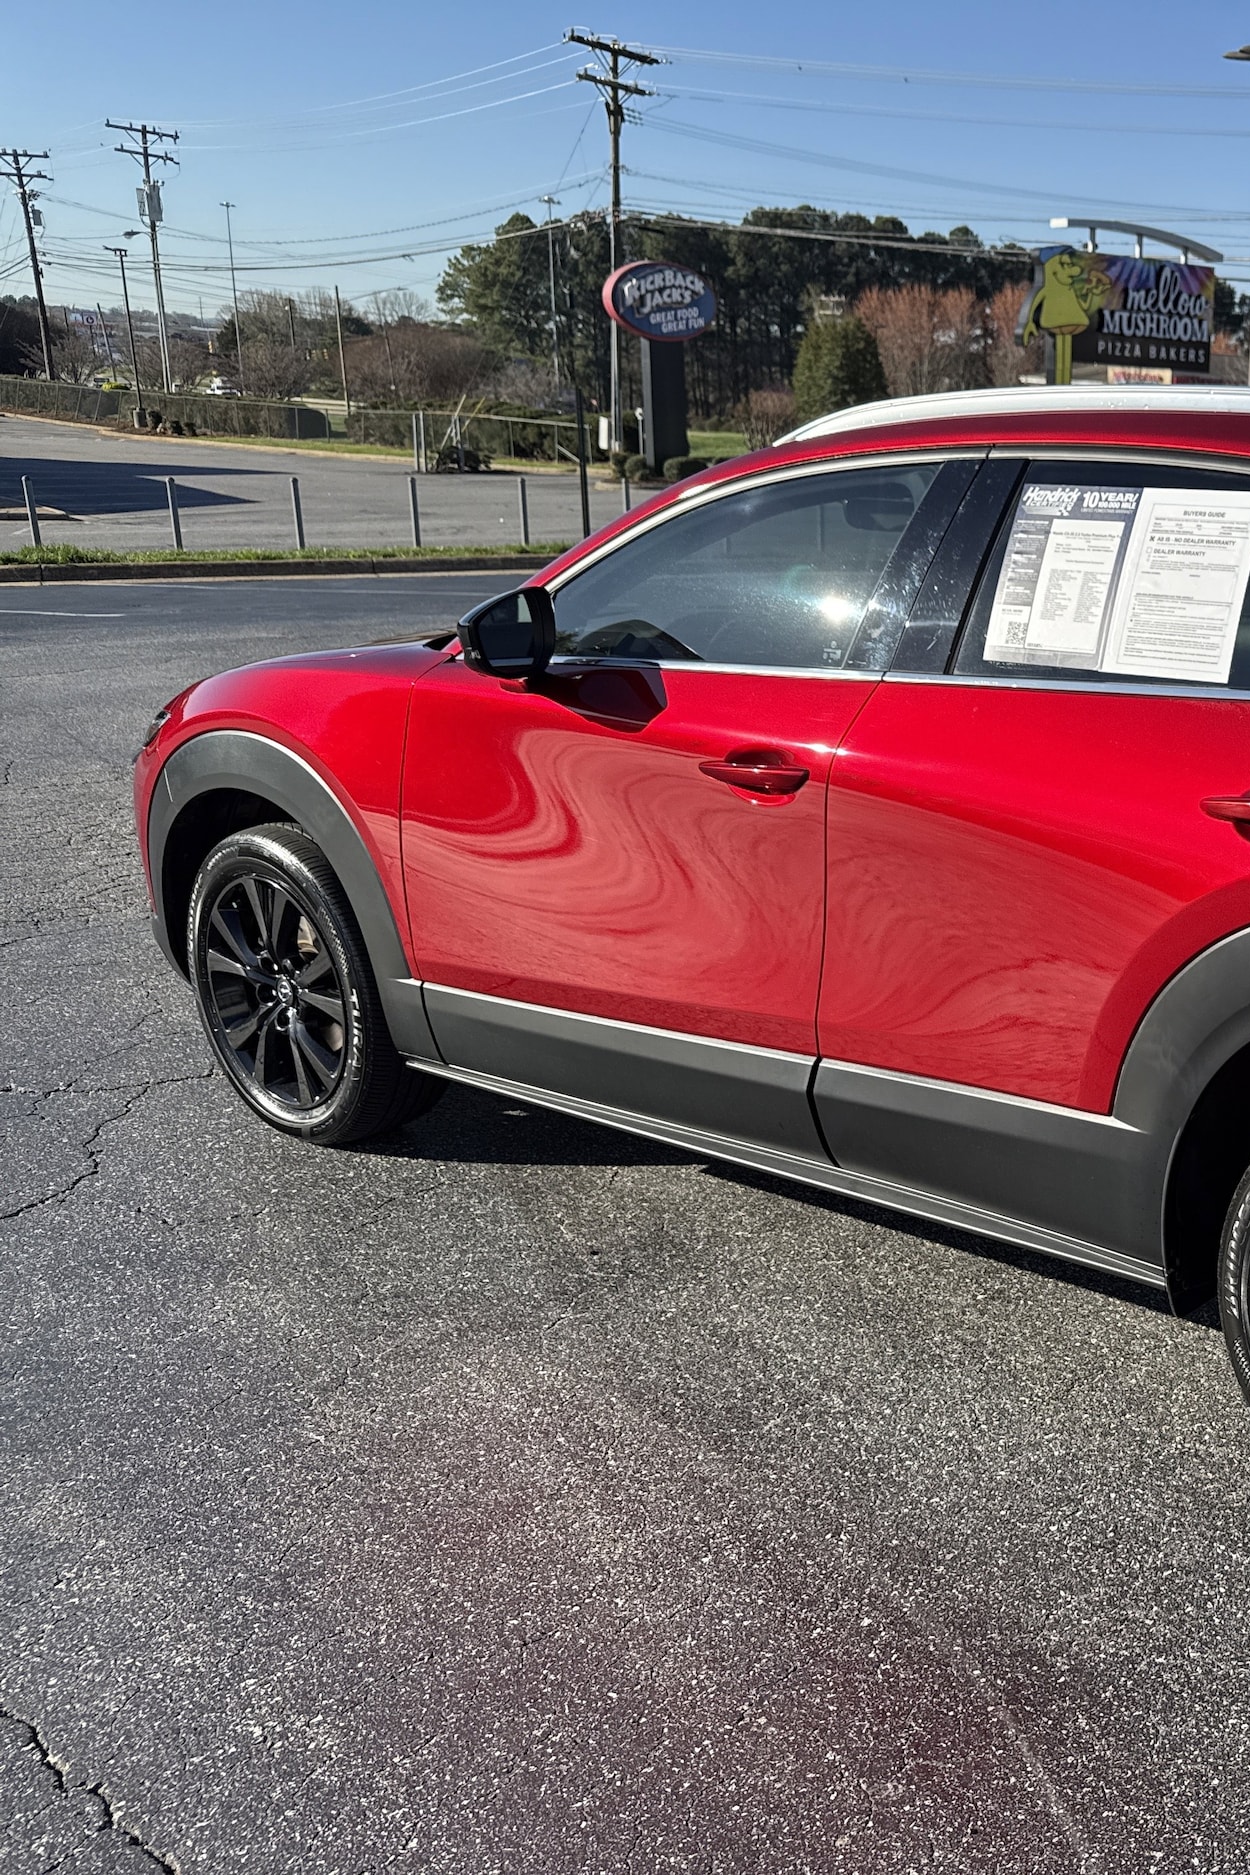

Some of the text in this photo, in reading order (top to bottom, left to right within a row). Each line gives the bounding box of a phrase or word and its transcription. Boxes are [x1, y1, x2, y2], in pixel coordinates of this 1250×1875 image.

[623, 269, 705, 306] KICKBACK
[1127, 266, 1207, 317] mellow
[641, 287, 692, 314] JACK'S
[649, 306, 699, 325] GREAT FOOD
[661, 317, 705, 333] GREAT FUN
[1102, 309, 1209, 343] MUSHROOM
[1097, 340, 1206, 364] PIZZA BAKERS
[1023, 487, 1081, 506] Hendrick
[1083, 491, 1100, 508] 10
[1120, 502, 1137, 510] MILE
[1183, 510, 1206, 518] BUYERS
